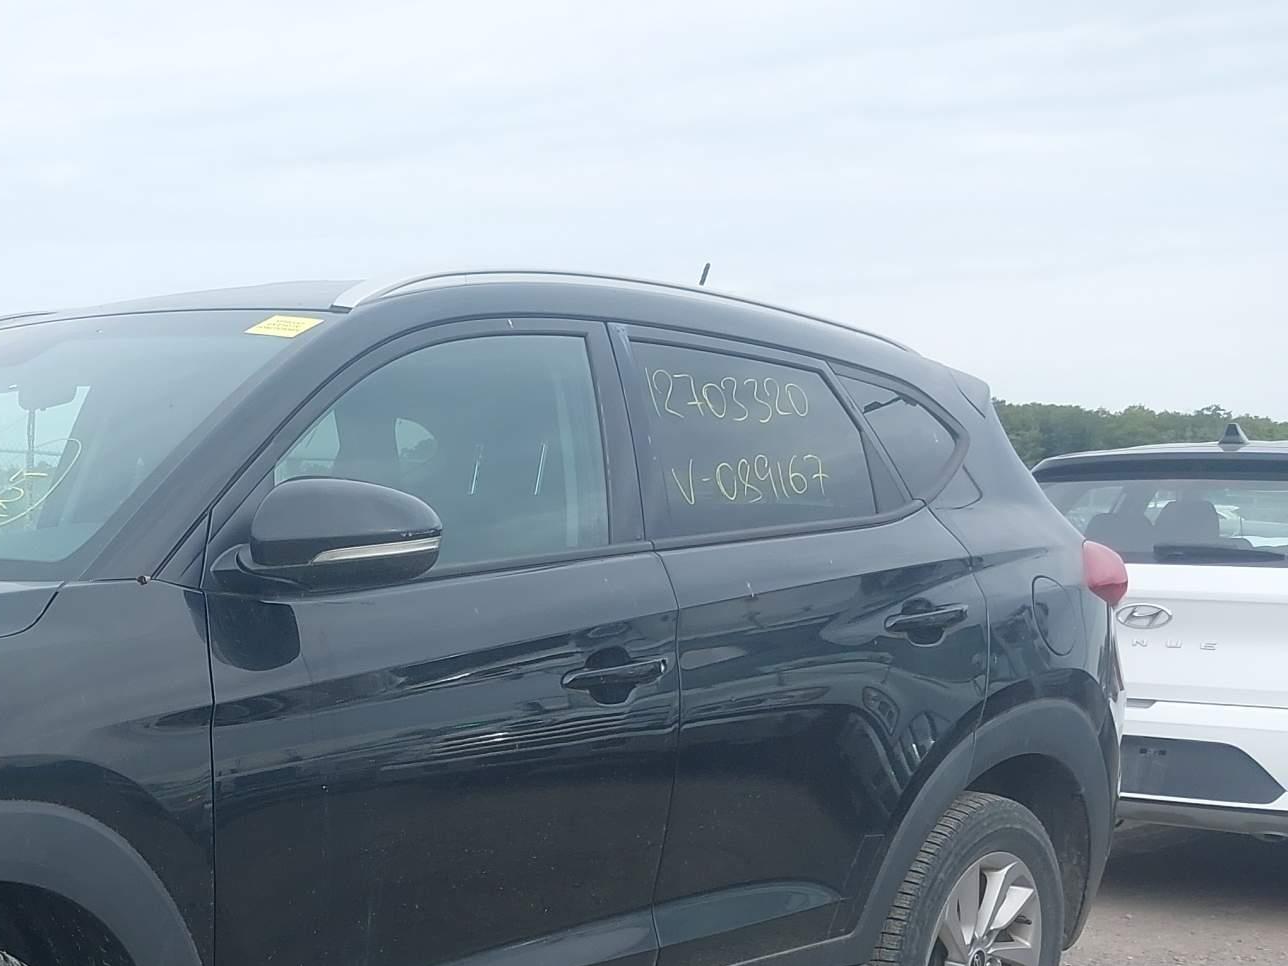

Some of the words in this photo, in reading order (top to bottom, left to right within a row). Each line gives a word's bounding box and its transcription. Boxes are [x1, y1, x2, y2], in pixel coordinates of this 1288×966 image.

[644, 367, 810, 424] 12703320
[671, 453, 831, 506] V-089167
[1130, 638, 1219, 652] NUE
